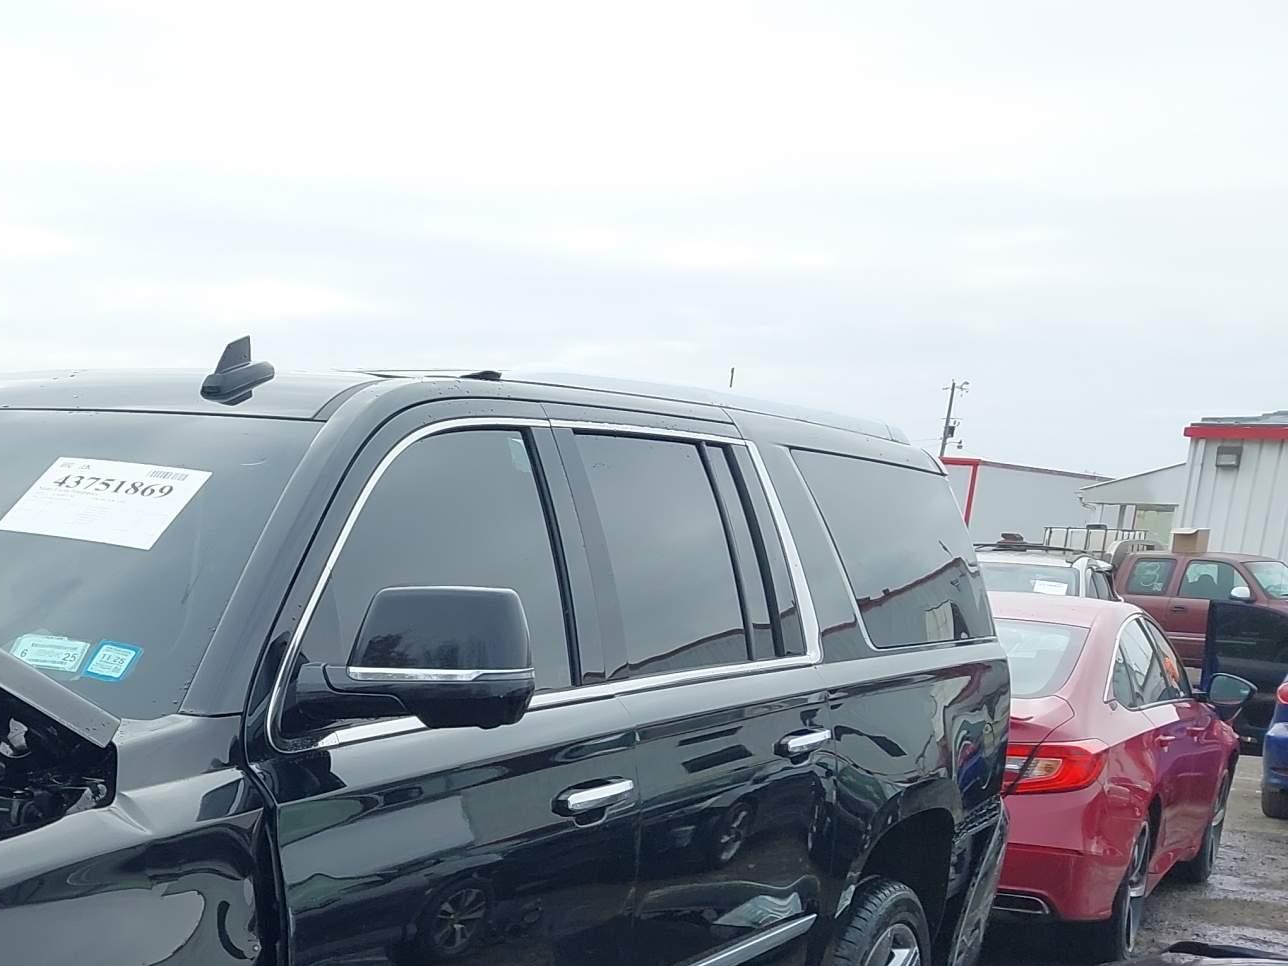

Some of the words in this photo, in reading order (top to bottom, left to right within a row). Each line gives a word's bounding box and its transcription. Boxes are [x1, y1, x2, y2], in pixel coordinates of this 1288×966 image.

[53, 474, 174, 498] 43751869
[20, 648, 29, 658] 6
[62, 652, 80, 662] 25
